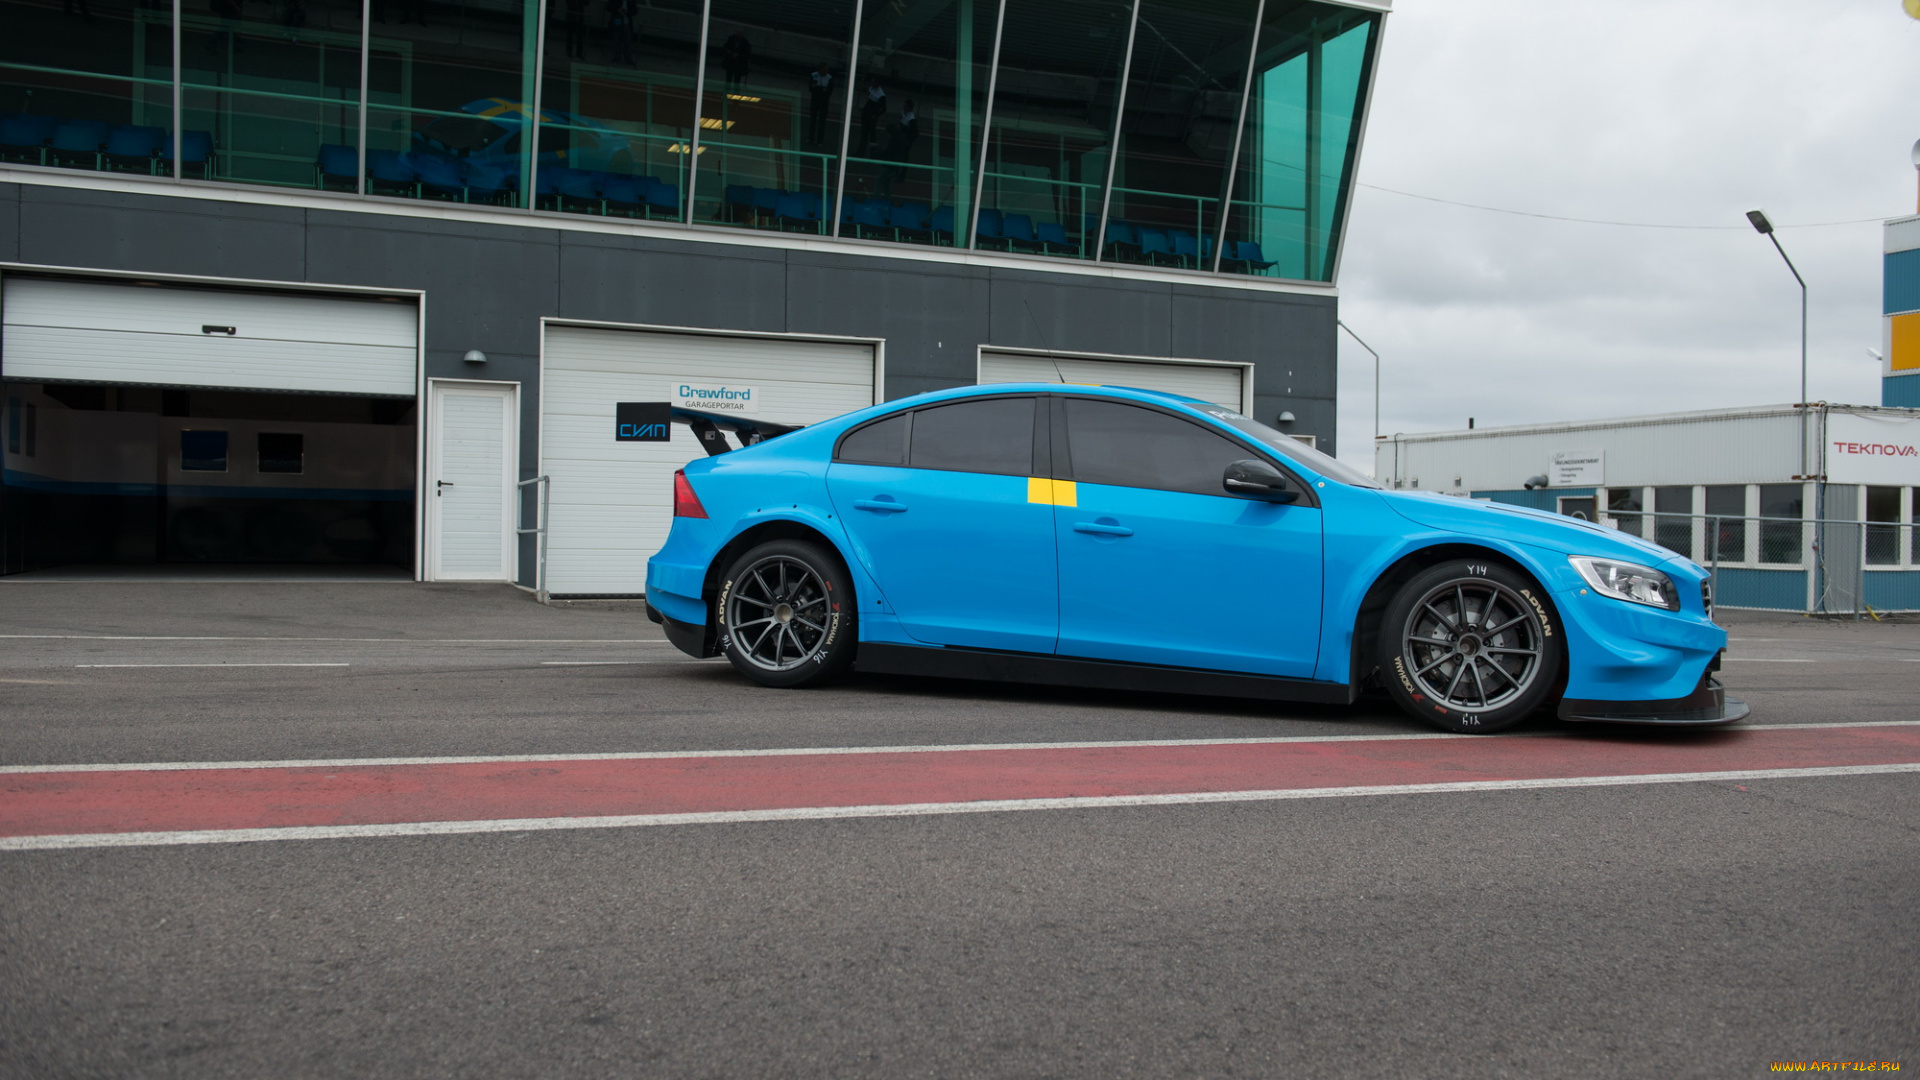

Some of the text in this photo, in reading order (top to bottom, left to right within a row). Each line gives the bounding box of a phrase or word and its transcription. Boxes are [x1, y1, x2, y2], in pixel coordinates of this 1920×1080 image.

[679, 385, 751, 400] Crawford
[685, 401, 745, 410] GARAGEPORTAR
[620, 424, 666, 438] CYAN
[1833, 442, 1918, 457] TEKNOVA
[1467, 565, 1487, 576] Y14
[719, 580, 733, 625] ADVAN
[1520, 589, 1552, 637] ADVAN
[825, 612, 840, 645] YOKOHAMA
[813, 649, 829, 664] Y16
[1395, 656, 1415, 694] YOKOHAMA
